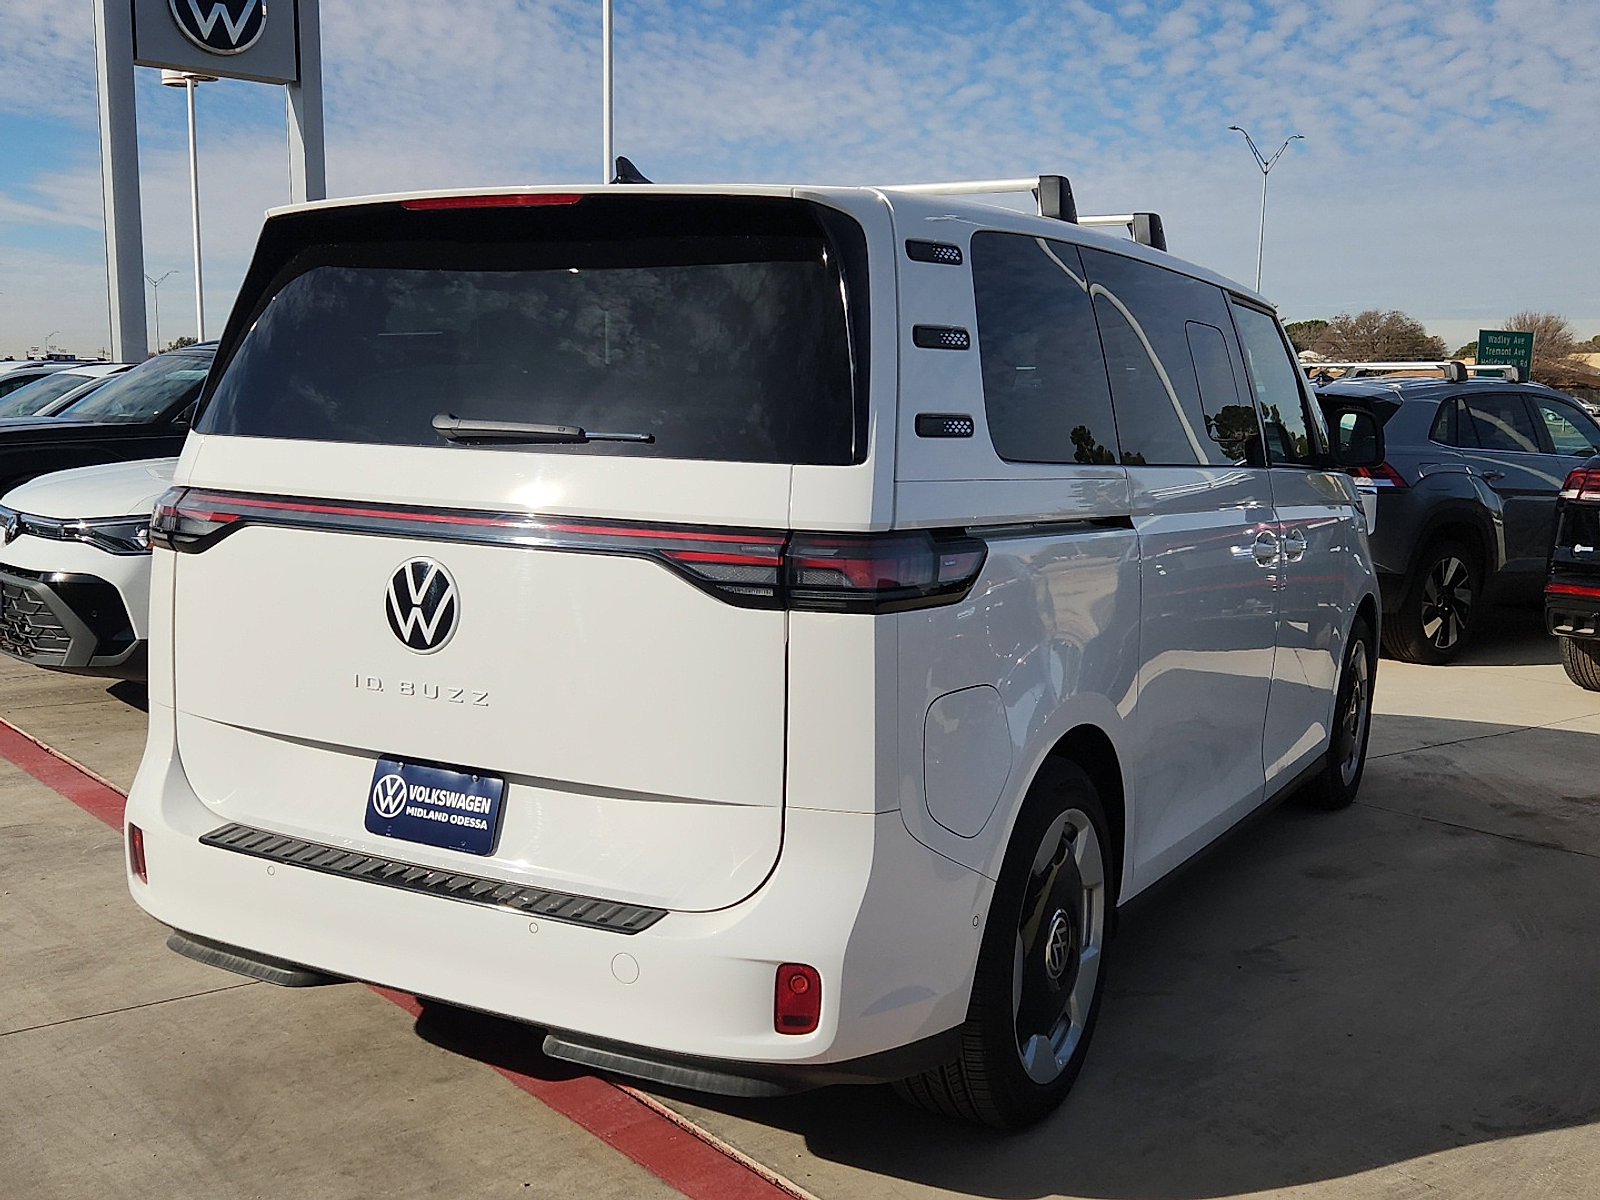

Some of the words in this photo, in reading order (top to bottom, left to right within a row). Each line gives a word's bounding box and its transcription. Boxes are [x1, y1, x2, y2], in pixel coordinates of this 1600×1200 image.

[1486, 346, 1511, 356] Tremont
[1514, 348, 1525, 356] Ave
[1488, 336, 1511, 345] Wadley
[1514, 336, 1525, 345] Ave
[400, 681, 490, 707] BUZZ
[373, 774, 407, 818] VW
[409, 784, 492, 814] VOLKSWAGEN
[405, 805, 449, 823] MIDLAND
[450, 814, 488, 830] ODESSA
